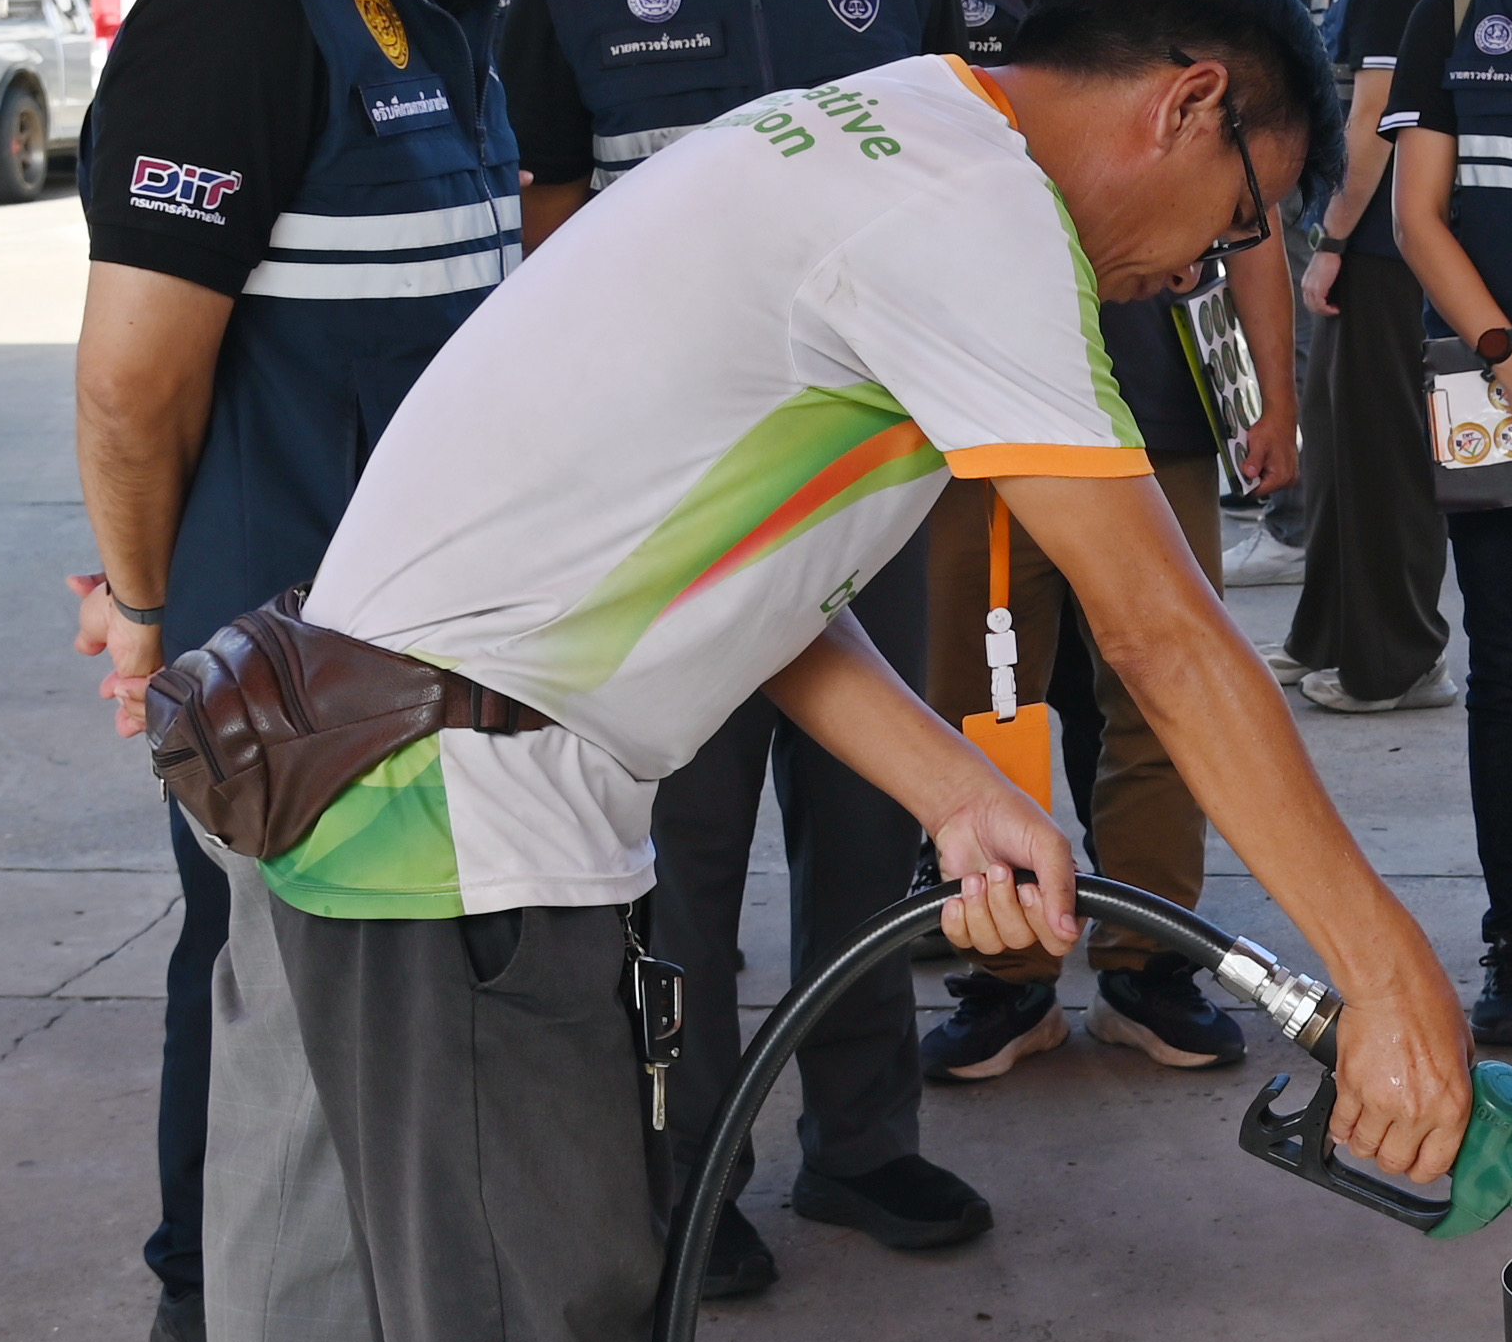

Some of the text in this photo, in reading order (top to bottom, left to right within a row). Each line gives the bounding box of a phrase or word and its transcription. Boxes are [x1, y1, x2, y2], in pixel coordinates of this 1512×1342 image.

[800, 85, 902, 161] ative
[130, 196, 226, 226] กรมการค้าภายใน
